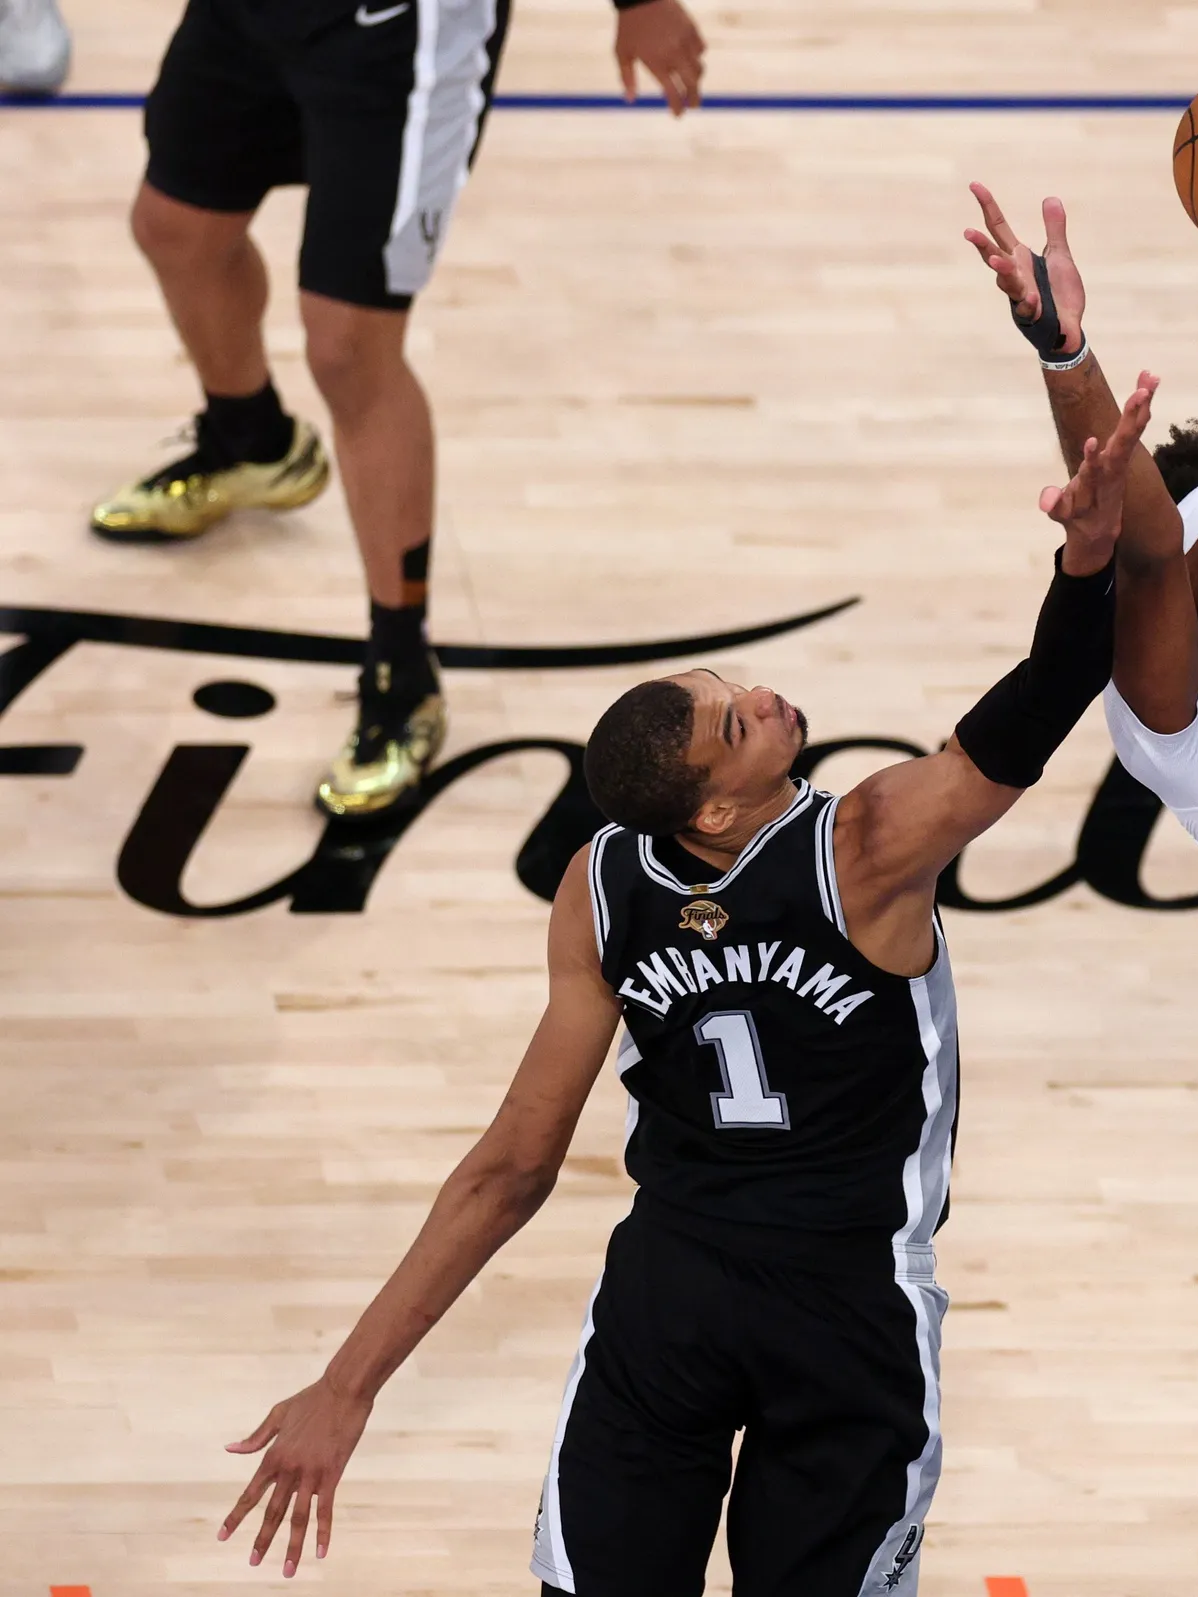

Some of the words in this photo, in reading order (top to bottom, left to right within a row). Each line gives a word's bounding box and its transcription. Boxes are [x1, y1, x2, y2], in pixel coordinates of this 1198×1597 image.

[679, 907, 726, 927] Finals
[615, 940, 875, 1025] EMBANYAMA
[693, 1010, 791, 1130] 1
